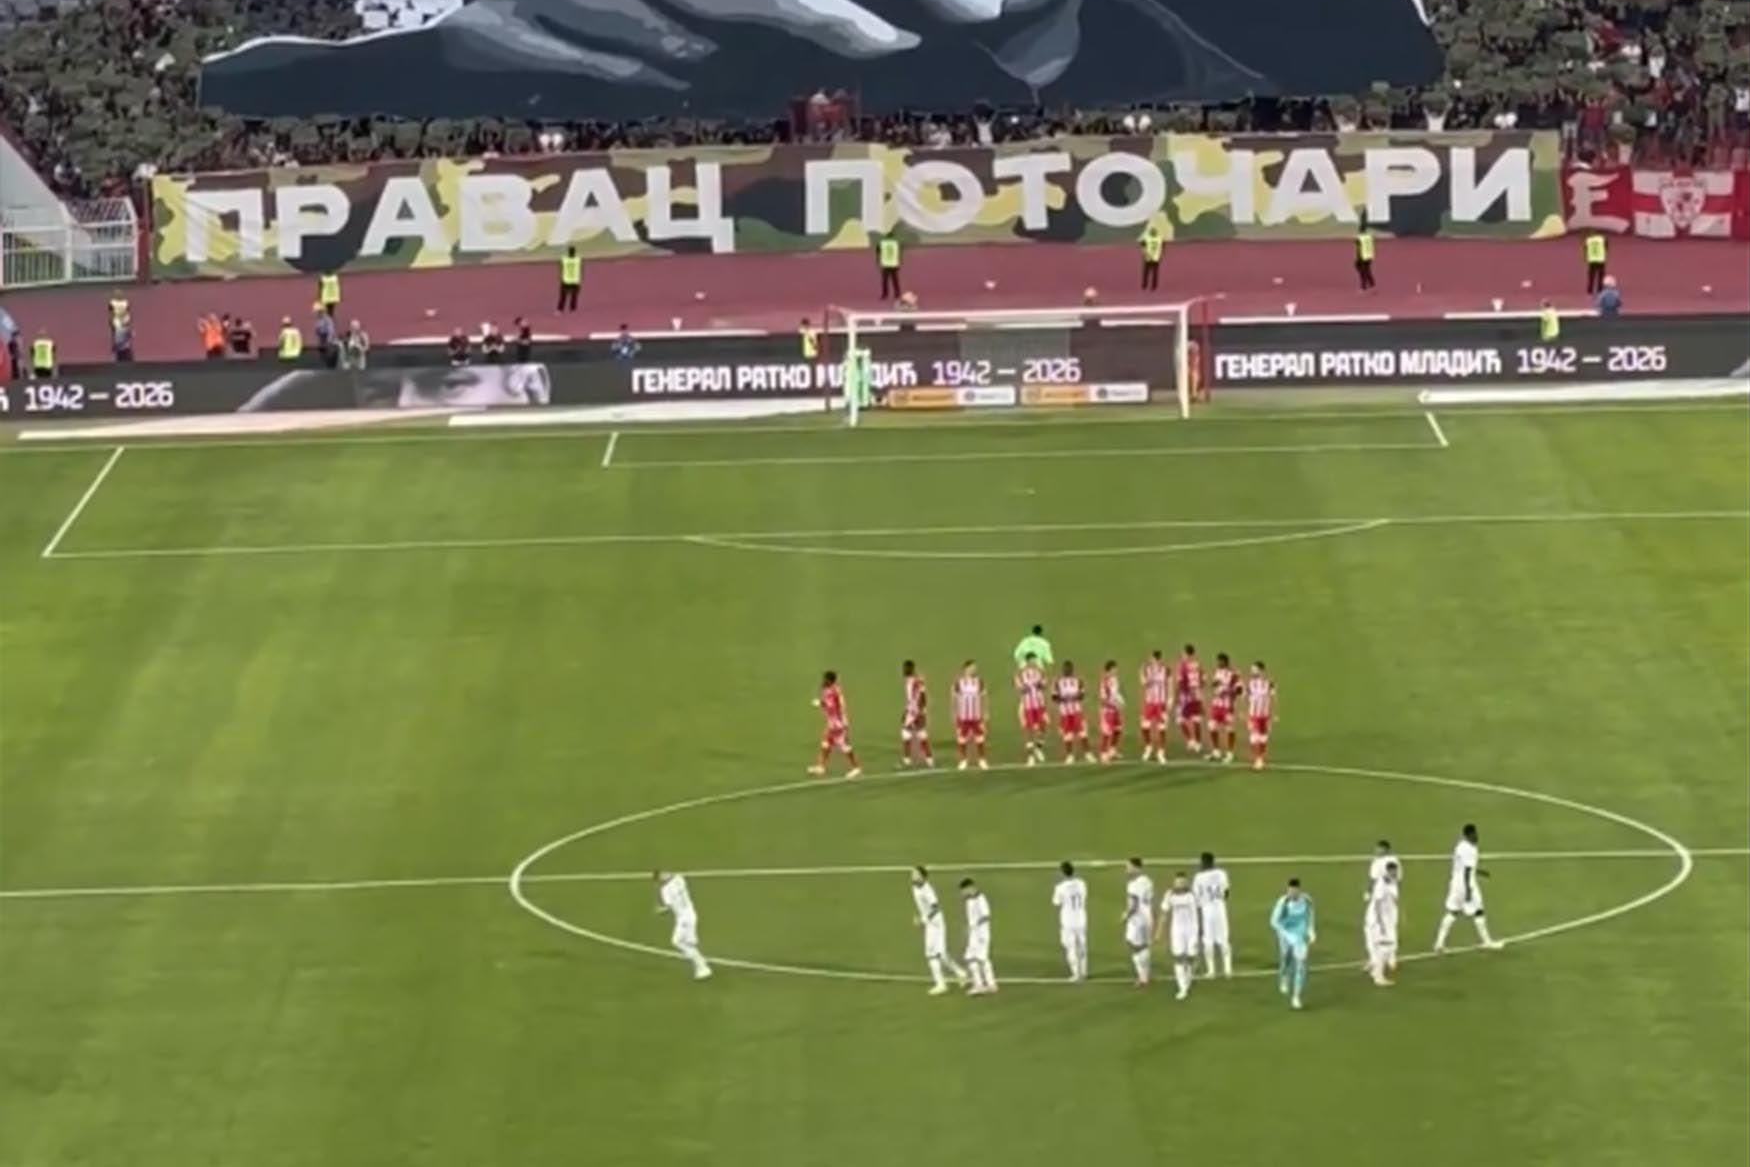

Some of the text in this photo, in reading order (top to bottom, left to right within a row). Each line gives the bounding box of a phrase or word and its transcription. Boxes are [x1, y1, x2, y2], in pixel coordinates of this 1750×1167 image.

[185, 147, 1532, 262] ПРАВАЦ ПОТОЧАРИ
[632, 367, 731, 393] ГЕНЕРАЛ
[737, 364, 811, 390] РАТКО
[816, 362, 918, 388] МДИЋ
[932, 360, 991, 385] 1942
[1022, 358, 1081, 383] 2026
[1215, 353, 1315, 378] ГЕНЕРАЛ
[1321, 350, 1395, 376] РАТКО
[1401, 348, 1501, 376] МЛАДИЋ
[1517, 347, 1576, 373] 1942
[1608, 346, 1667, 371] 2026
[25, 386, 84, 411] 1942
[115, 383, 174, 408] 2026
